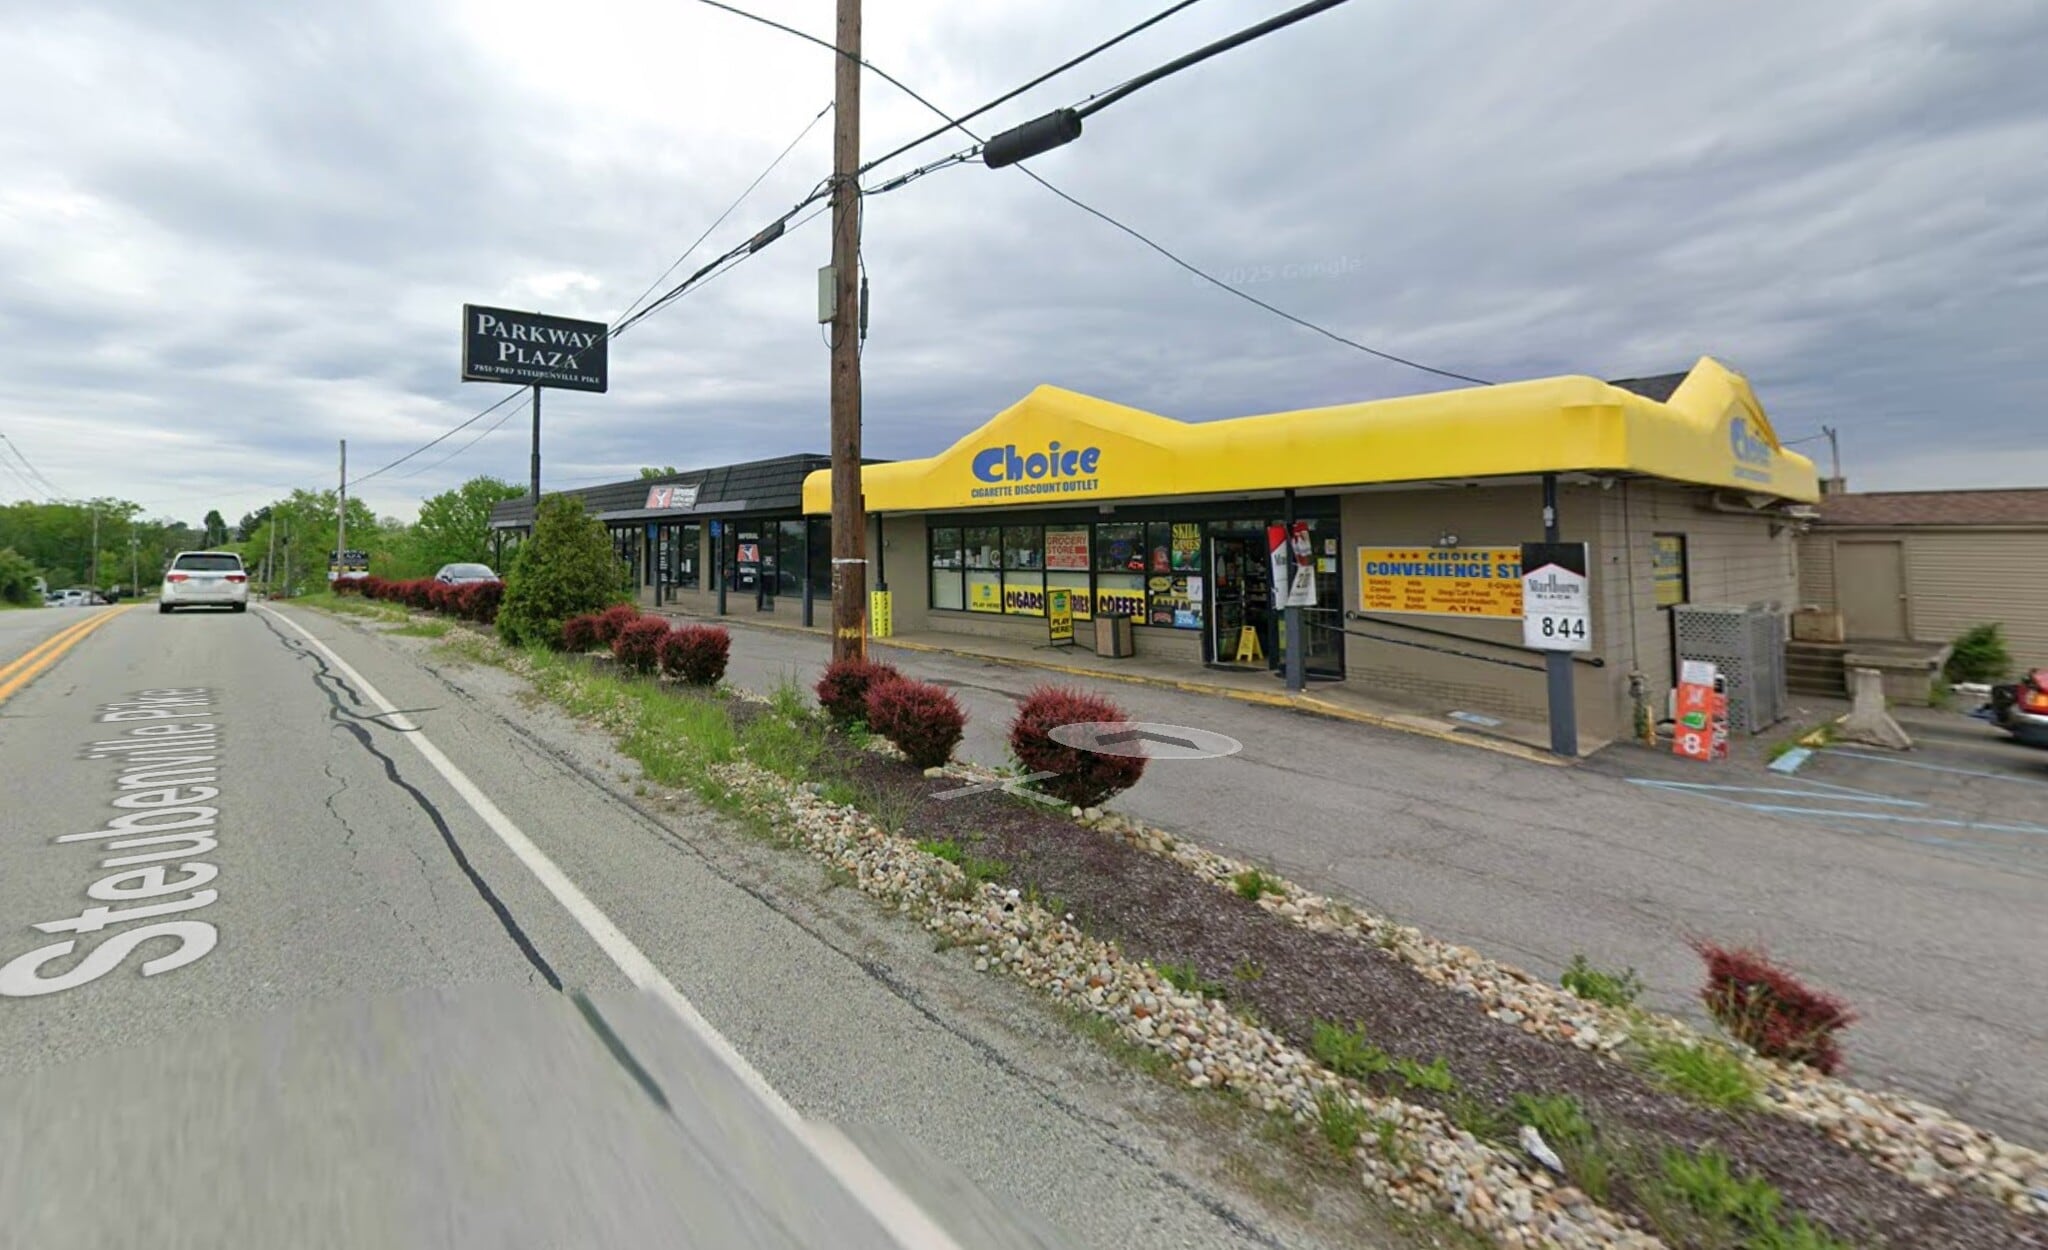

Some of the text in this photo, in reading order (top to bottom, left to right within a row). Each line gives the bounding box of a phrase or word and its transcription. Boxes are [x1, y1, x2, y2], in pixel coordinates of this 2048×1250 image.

[477, 313, 598, 349] PARKWAY
[498, 341, 579, 369] PLAZA
[581, 376, 600, 384] PIKE
[972, 441, 1101, 483] Choice
[971, 479, 1099, 498] CIGARETTE DISCOUNT OUTLET
[1173, 523, 1200, 539] SKILL
[1047, 545, 1074, 555] STORE
[1428, 552, 1490, 561] CHOICE
[1366, 561, 1493, 578] CONVENIENCE
[1528, 573, 1579, 594] Marlboro
[1006, 591, 1044, 610] CIGARS
[1099, 595, 1145, 616] COFFEE
